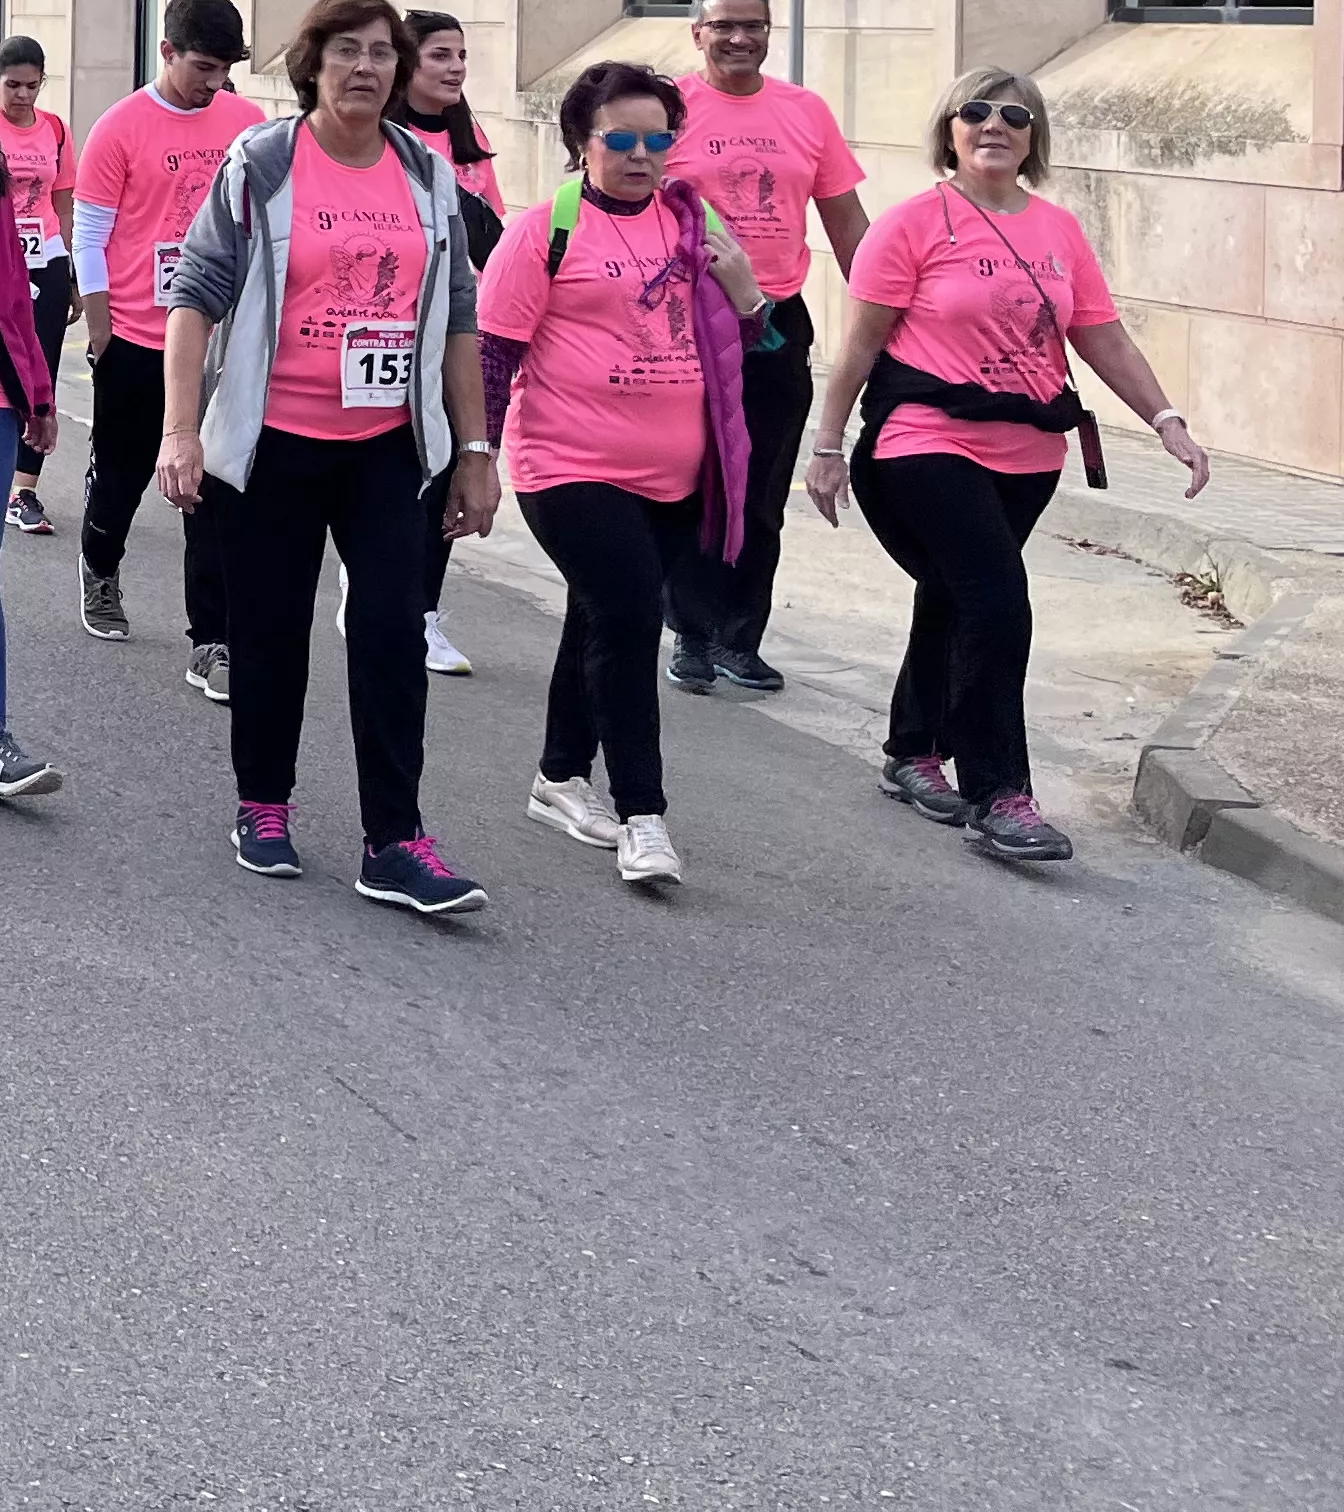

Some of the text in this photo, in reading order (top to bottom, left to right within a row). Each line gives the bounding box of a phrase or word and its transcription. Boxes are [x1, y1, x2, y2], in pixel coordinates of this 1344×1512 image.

[341, 208, 400, 223] CÁNCER
[373, 223, 413, 232] HUESCA
[352, 338, 386, 347] CONTRA
[388, 339, 397, 347] EL
